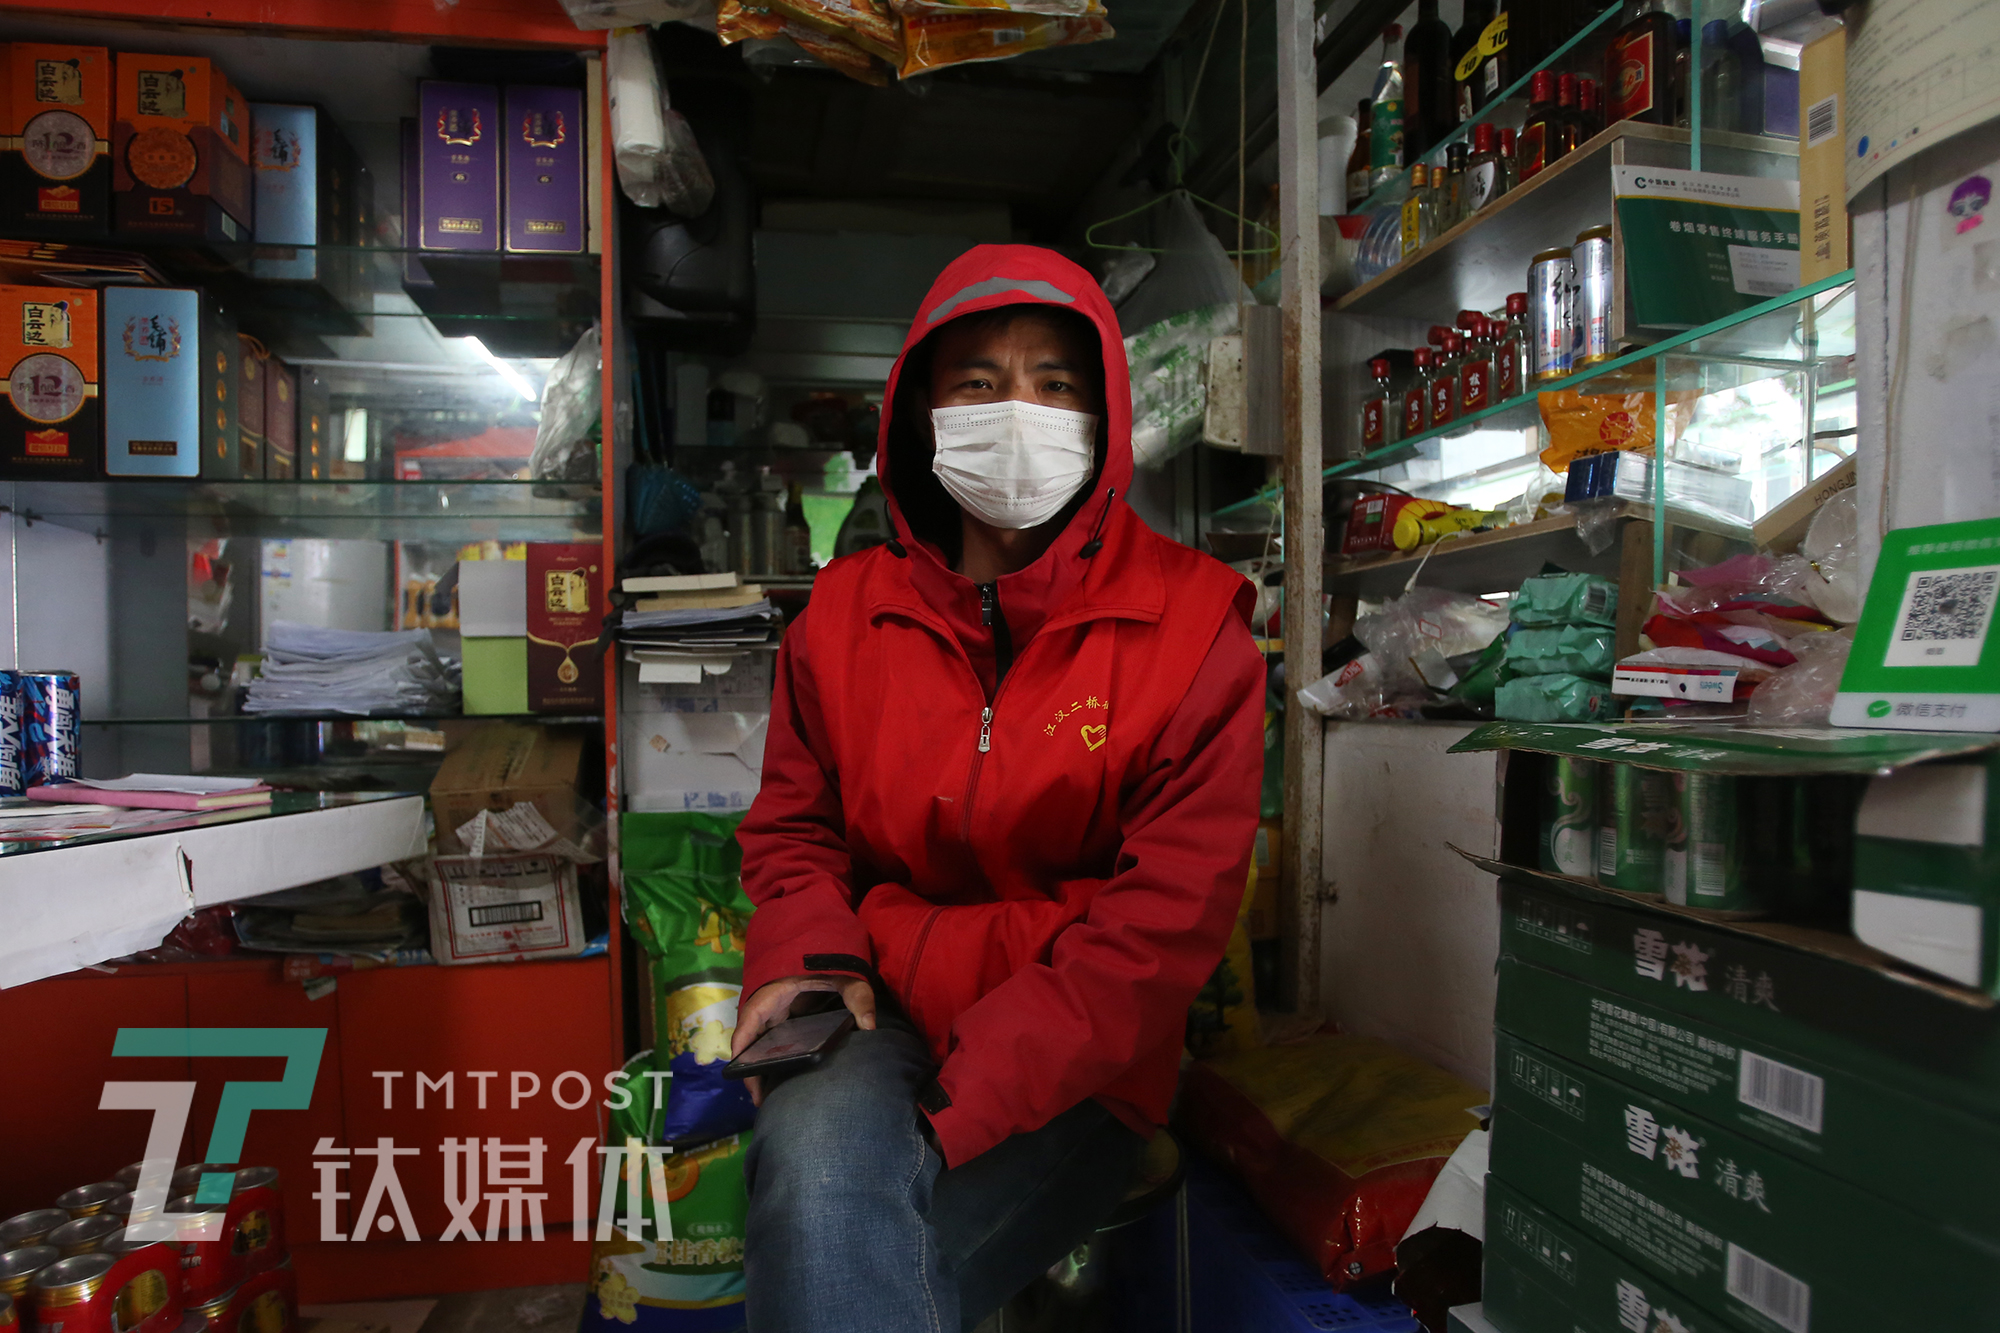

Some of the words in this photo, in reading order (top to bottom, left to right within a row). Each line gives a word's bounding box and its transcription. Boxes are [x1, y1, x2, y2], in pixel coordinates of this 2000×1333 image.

[39, 63, 58, 100] 白云边
[142, 75, 161, 112] 白云边
[151, 200, 172, 213] 15
[1669, 220, 1799, 245] 卷烟零售终端服务手册
[26, 305, 46, 343] 白云边
[147, 315, 167, 356] 毛铺
[30, 375, 65, 397] 12
[1907, 537, 2000, 556] 推荐使用微信
[549, 574, 567, 608] 白云边
[1896, 702, 1967, 719] 微信支付
[1634, 928, 1710, 991] 雪花
[1725, 964, 1780, 1013] 清爽
[1625, 1104, 1699, 1179] 雪花
[1715, 1157, 1772, 1213] 清爽
